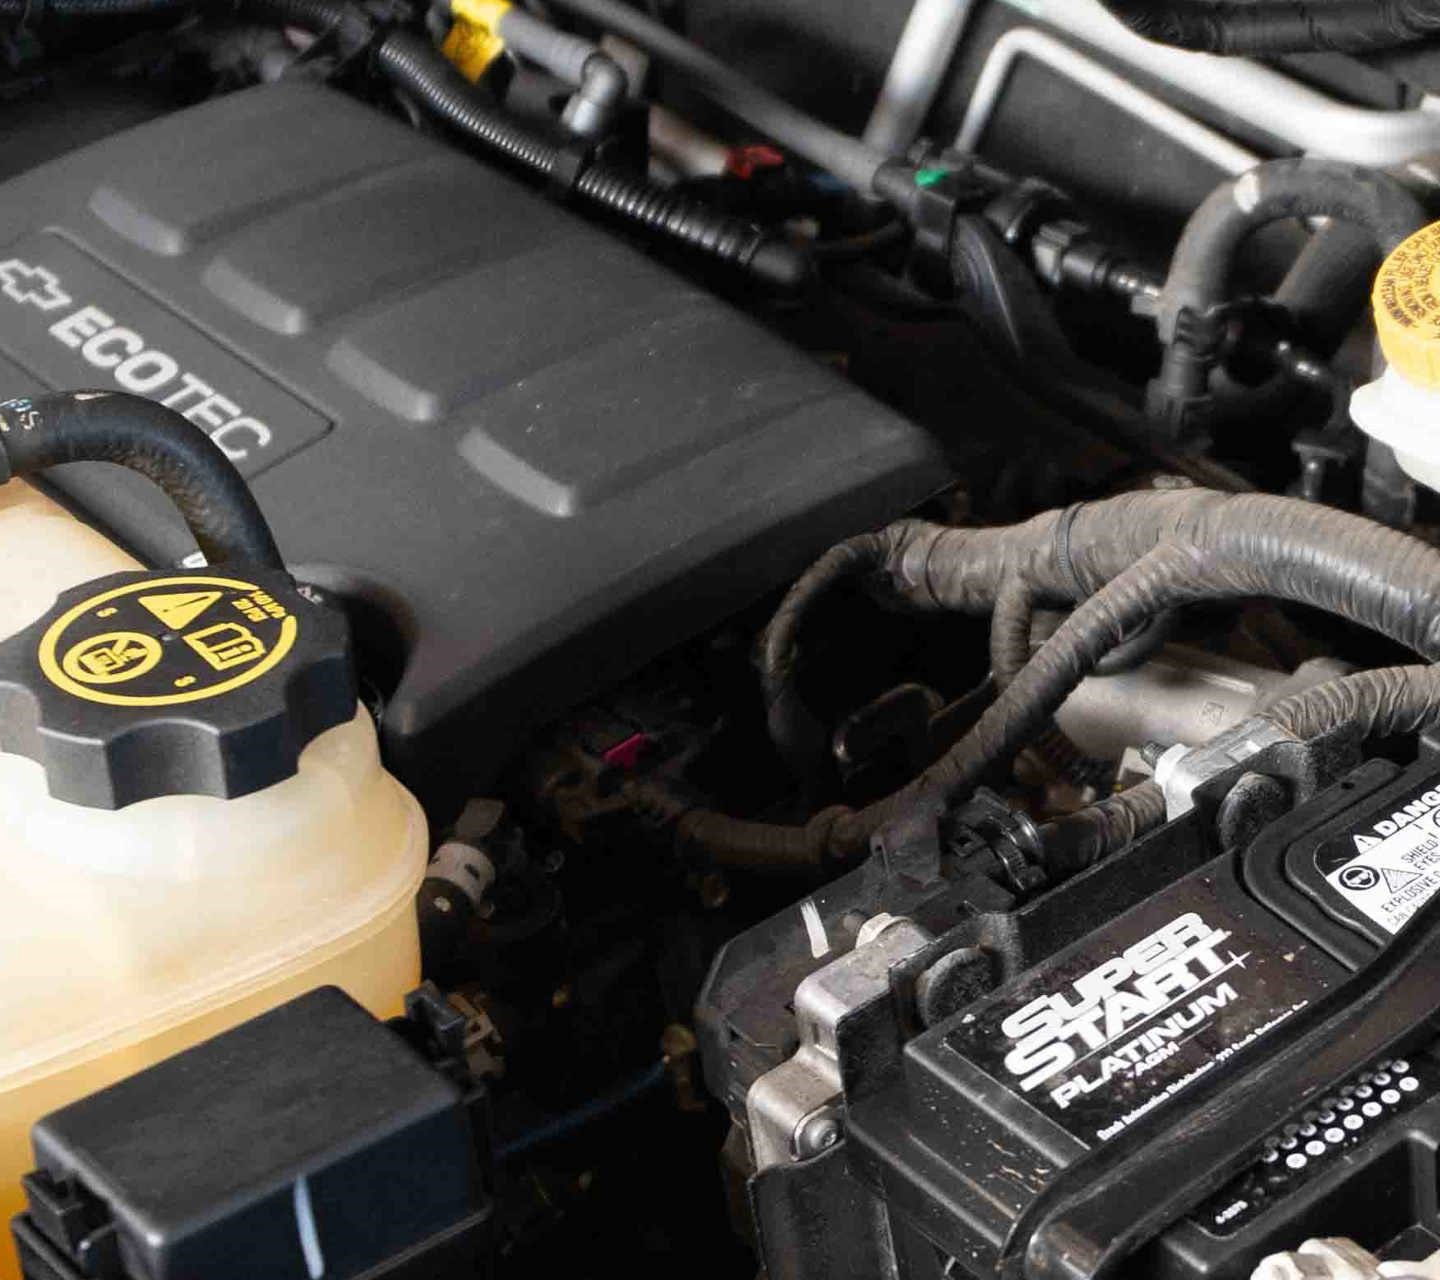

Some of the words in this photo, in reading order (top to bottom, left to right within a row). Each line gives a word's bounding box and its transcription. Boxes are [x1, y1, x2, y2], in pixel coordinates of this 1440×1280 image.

[49, 305, 272, 461] ECOTEC
[1380, 874, 1438, 914] EXPLOSIVE
[1399, 837, 1439, 865] SHIELD
[1002, 912, 1210, 1042] SUPER
[1004, 931, 1229, 1092] START
[1049, 982, 1239, 1109] PLATINUM
[1128, 1040, 1183, 1076] AGM
